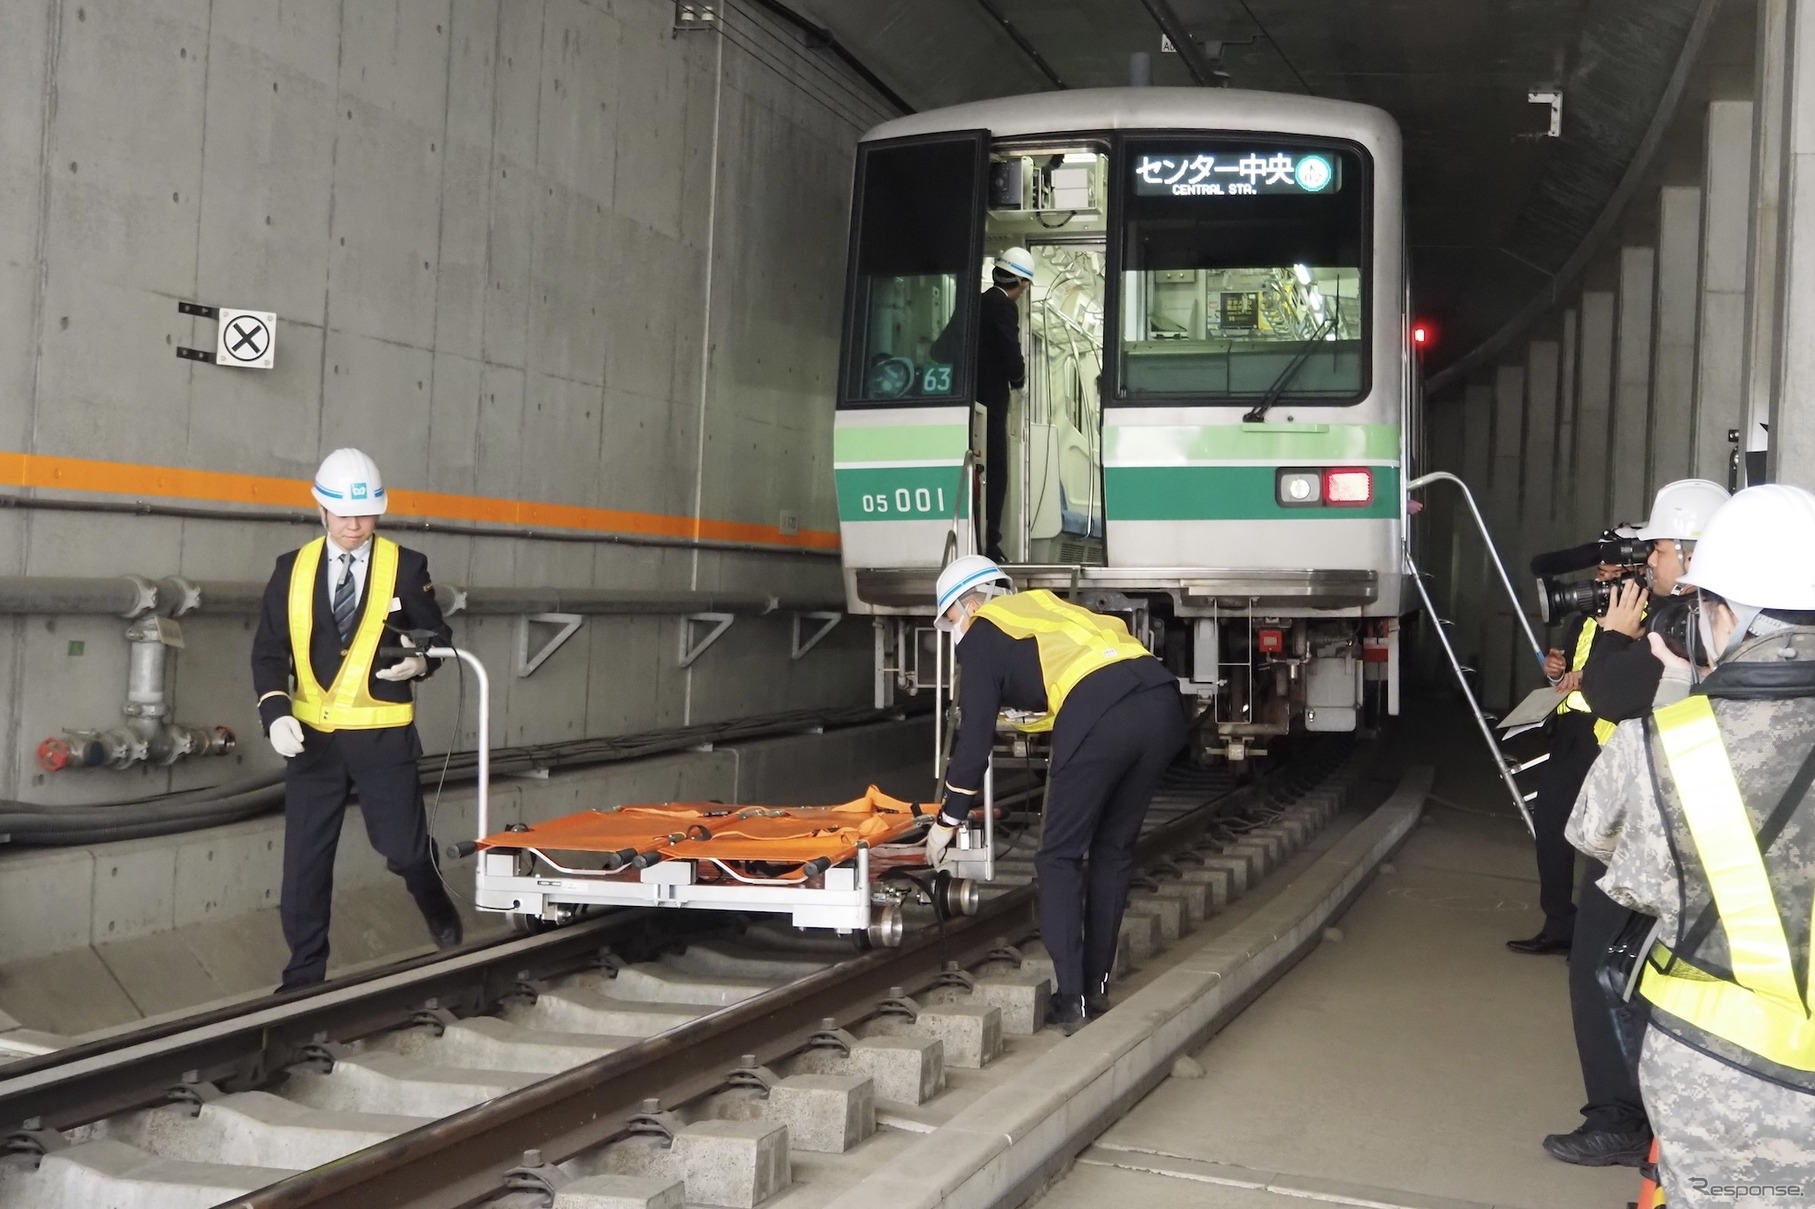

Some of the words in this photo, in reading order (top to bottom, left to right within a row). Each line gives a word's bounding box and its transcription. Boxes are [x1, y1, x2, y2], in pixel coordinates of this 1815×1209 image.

[1135, 153, 1295, 185] センター中央
[1172, 184, 1225, 195] CENTRAL
[1228, 184, 1257, 195] STA.
[923, 367, 951, 391] 63
